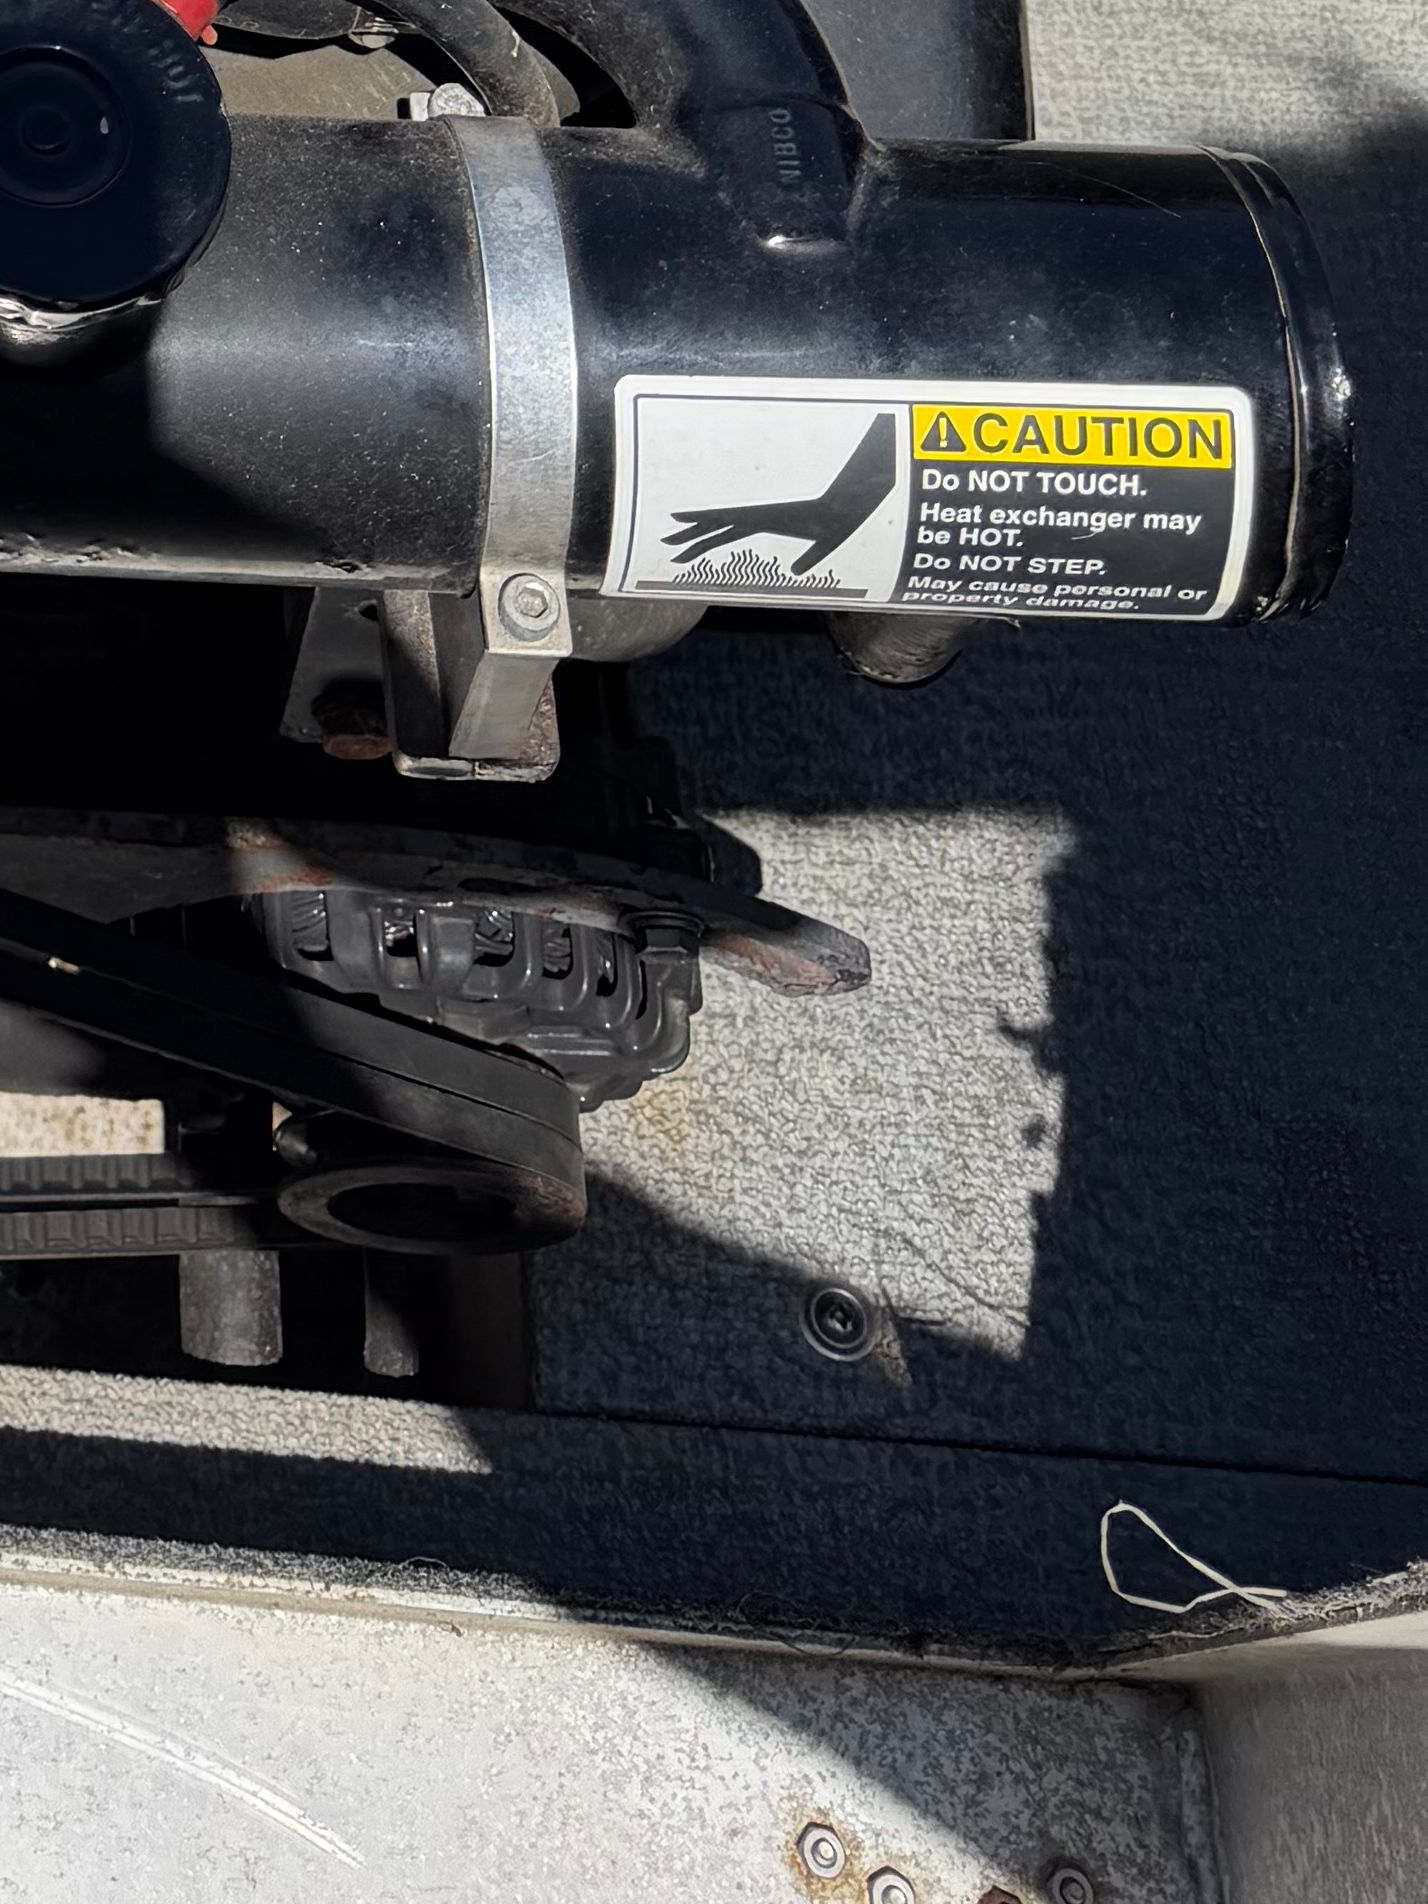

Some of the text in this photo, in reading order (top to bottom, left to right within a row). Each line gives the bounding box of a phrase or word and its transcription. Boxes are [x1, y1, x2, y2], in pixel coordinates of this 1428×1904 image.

[767, 107, 802, 184] NIBCO
[972, 413, 1225, 461] CAUTION
[921, 469, 1148, 497] Do NOT TOUCH.
[918, 502, 1202, 535] Heat exchanger may
[917, 526, 1024, 550] be HOT.
[913, 553, 1106, 577] Do NOT STEP.
[901, 592, 1141, 612] property damage.
[907, 576, 1209, 602] May cause personal or
